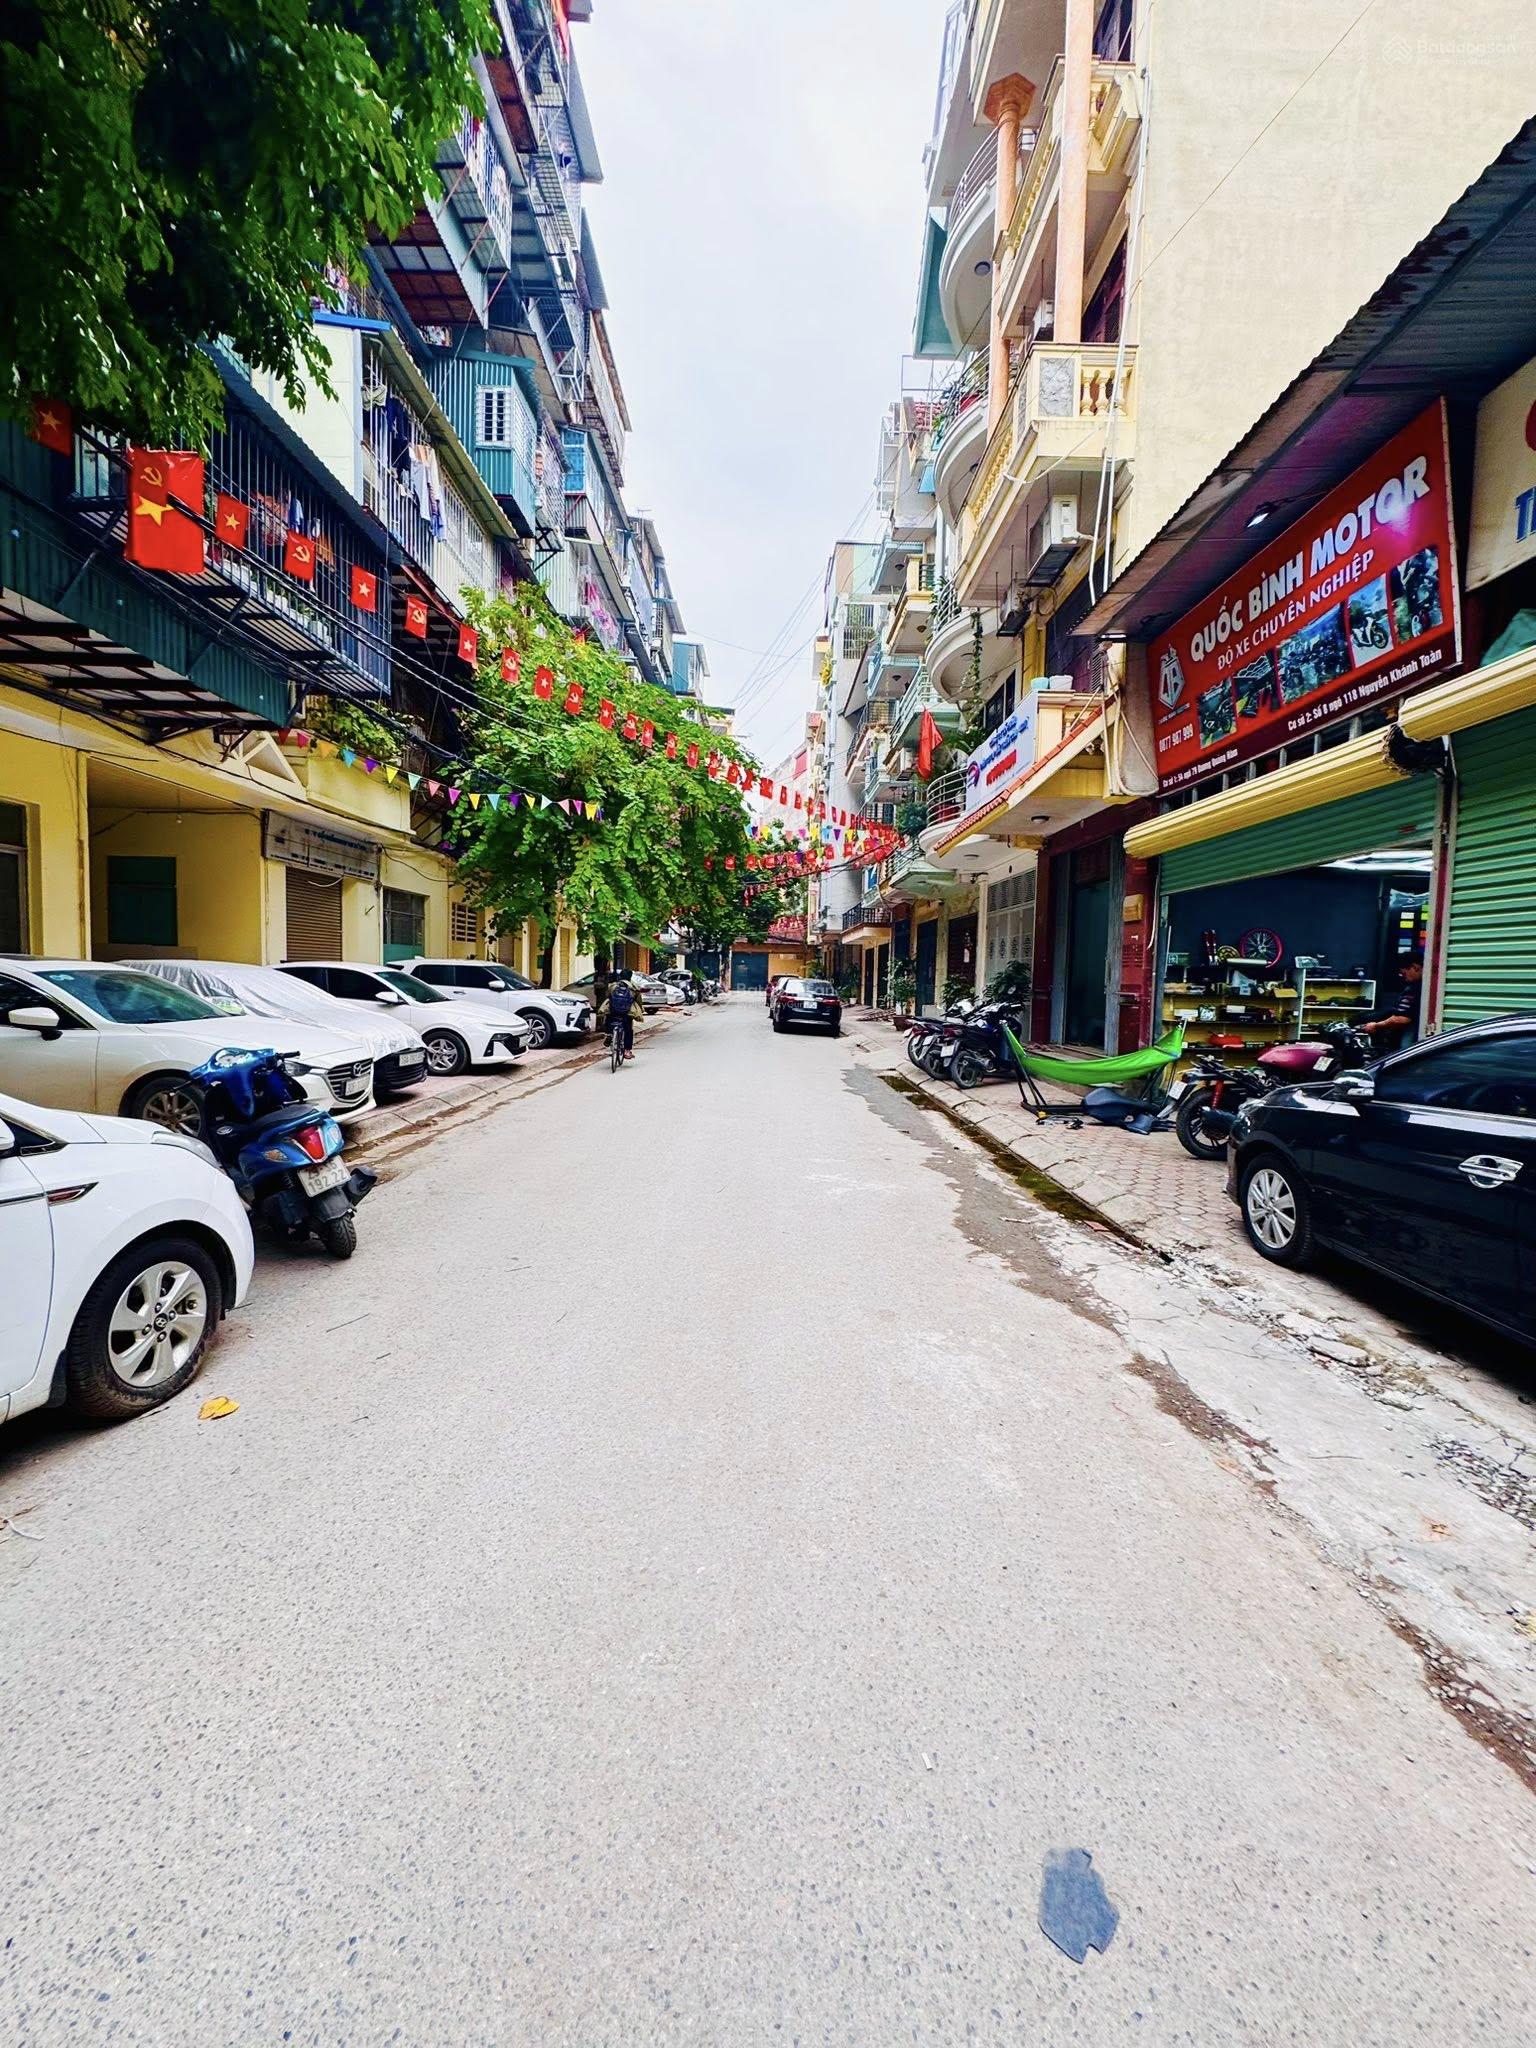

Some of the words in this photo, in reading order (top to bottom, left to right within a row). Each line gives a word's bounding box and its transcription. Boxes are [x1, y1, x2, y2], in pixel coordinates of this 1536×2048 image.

[1191, 596, 1243, 661] QUỐC
[1249, 551, 1303, 621] BÌNH
[1310, 456, 1430, 577] MOTOR
[1218, 644, 1234, 670] ĐỘ
[1236, 637, 1250, 658] XE
[1252, 595, 1306, 645] CHUYÊN
[1310, 549, 1374, 607] NGHIỆP
[1343, 689, 1358, 704] 118
[1358, 674, 1389, 698] Nguyễn
[1390, 660, 1418, 683] Khánh
[1419, 649, 1443, 668] Toàn
